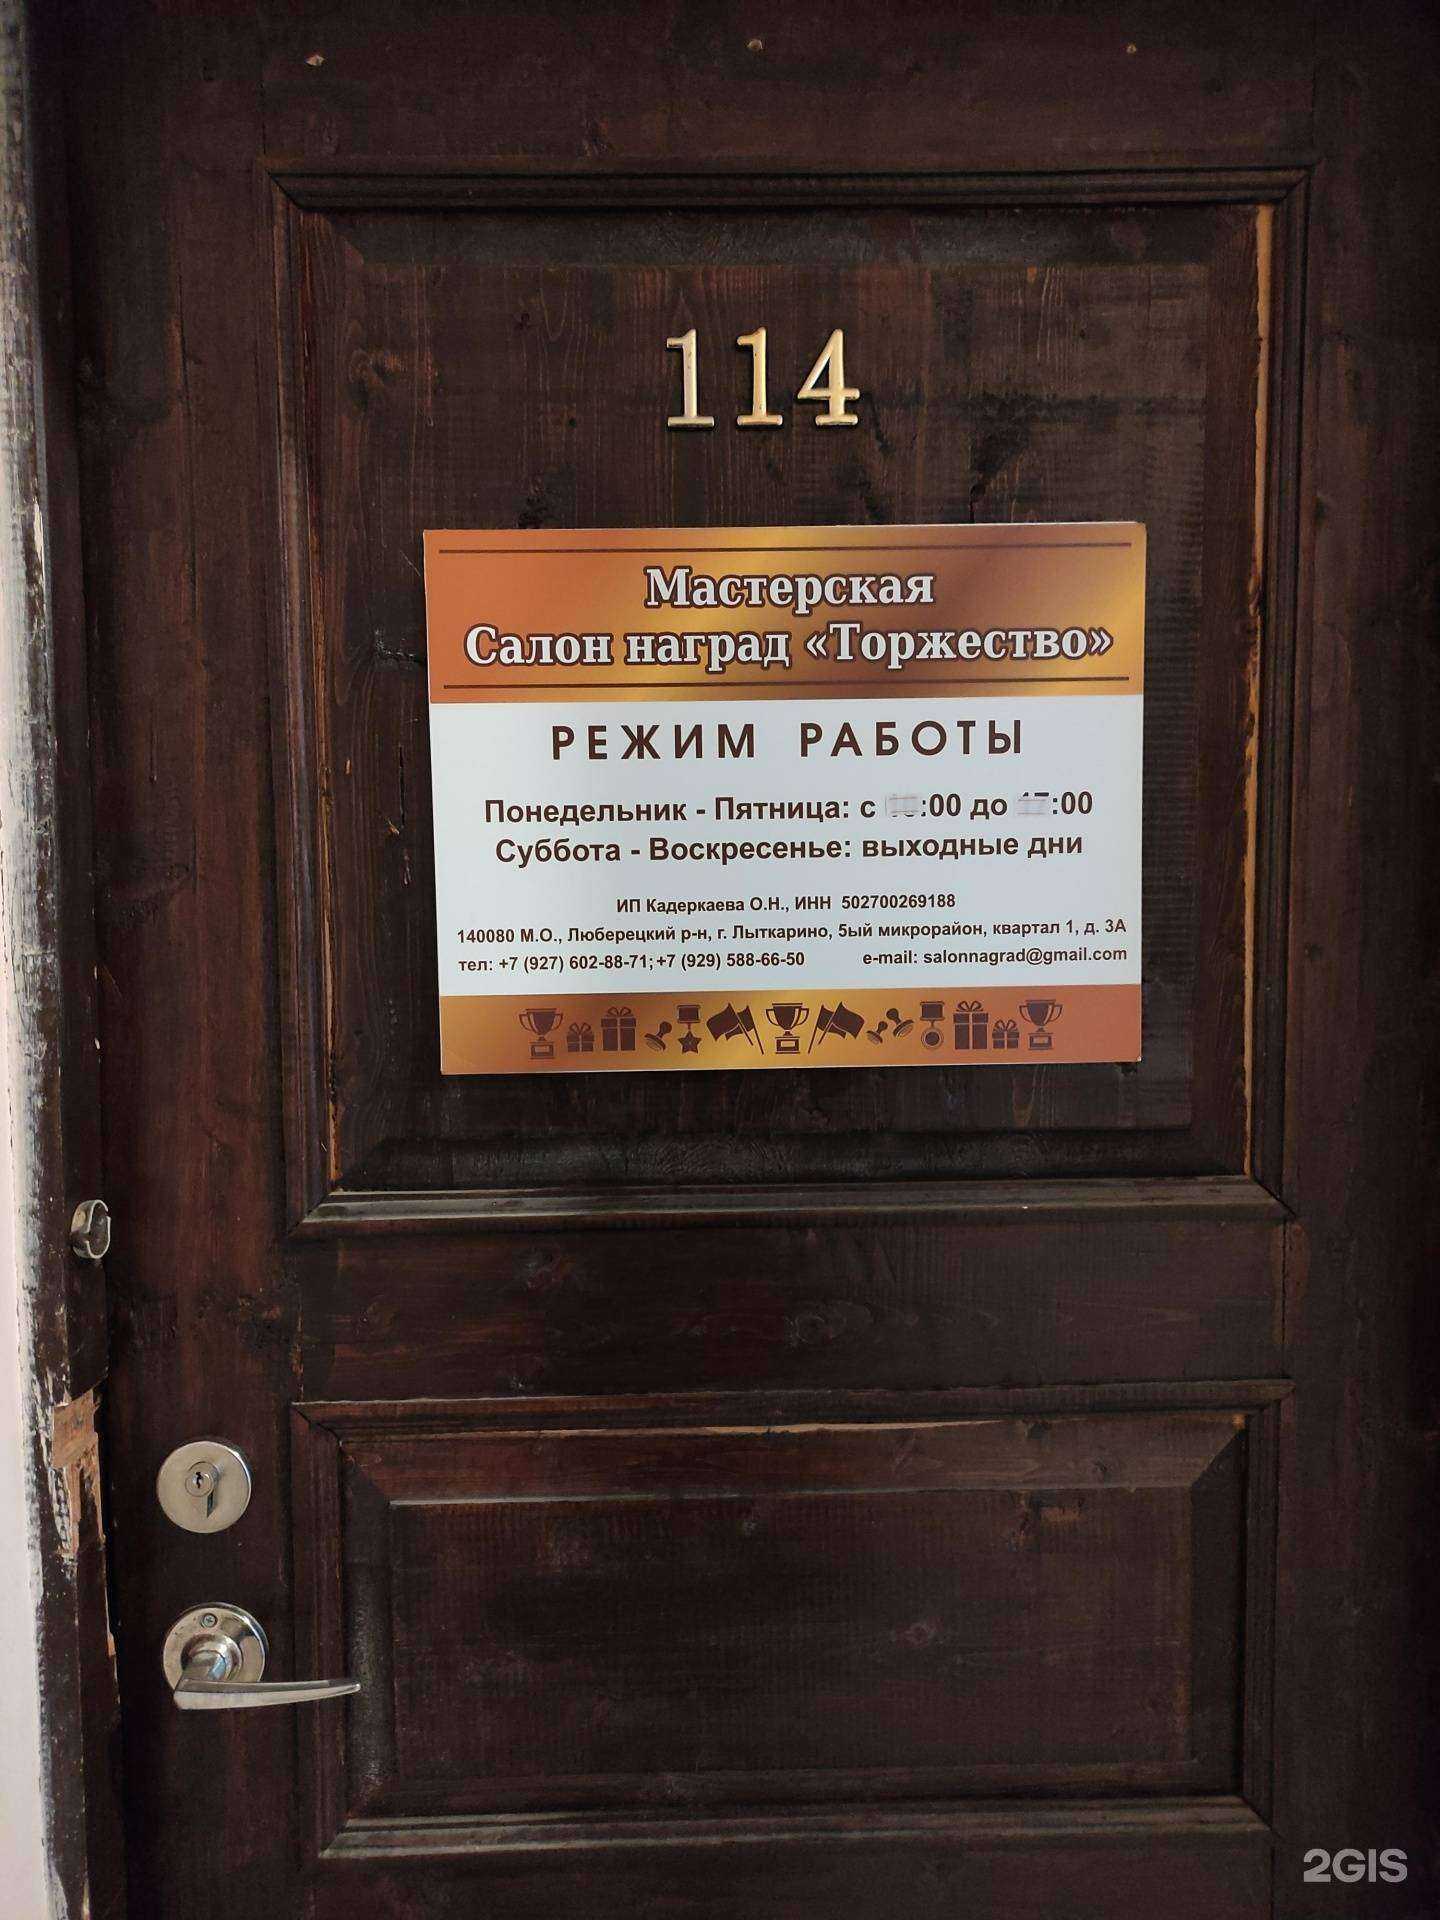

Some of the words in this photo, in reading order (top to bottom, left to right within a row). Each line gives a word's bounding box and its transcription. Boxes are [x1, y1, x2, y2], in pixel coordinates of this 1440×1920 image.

[666, 326, 861, 427] 114
[643, 565, 936, 615] Мастерская
[464, 624, 613, 668] Салон
[625, 625, 791, 674] наград
[805, 622, 1112, 670] «Торжество»
[552, 724, 755, 760] РЕЖИМ
[800, 720, 1021, 757] РАБОТЫ
[485, 800, 687, 826] Понедельник
[716, 796, 849, 821] Пятница:
[861, 800, 876, 818] с
[886, 794, 961, 817] :00
[970, 798, 1008, 820] до
[1018, 792, 1093, 815] :00
[496, 838, 621, 868] Суббота
[650, 834, 851, 864] Воскресенье:
[863, 836, 1019, 860] выходные
[1028, 836, 1083, 858] дни
[617, 899, 641, 912] ИП
[647, 898, 744, 914] Кадеркаева
[750, 897, 789, 912] О.Н.,
[795, 896, 831, 910] ИНН
[842, 894, 956, 909] 502700269188
[457, 930, 515, 943] 140080
[521, 929, 562, 945] М.О.,
[568, 926, 675, 944] Люберецкий
[681, 929, 712, 943] р-н,
[718, 929, 727, 940] г.
[732, 925, 832, 943] Лыткарино,
[838, 924, 872, 938] 5ый
[878, 922, 986, 939] микрорайон,
[993, 923, 1060, 937] квартал
[1066, 920, 1078, 935] 1,
[1084, 922, 1099, 935] д.
[1105, 919, 1127, 933] 3А
[459, 959, 493, 971] тел:
[499, 957, 518, 971] +7
[523, 957, 564, 972] (927)
[681, 954, 721, 970] (929)
[726, 952, 804, 967] 588-66-50
[863, 949, 918, 965] e-mail:
[923, 947, 1127, 964] salonnagrad@gmail.com
